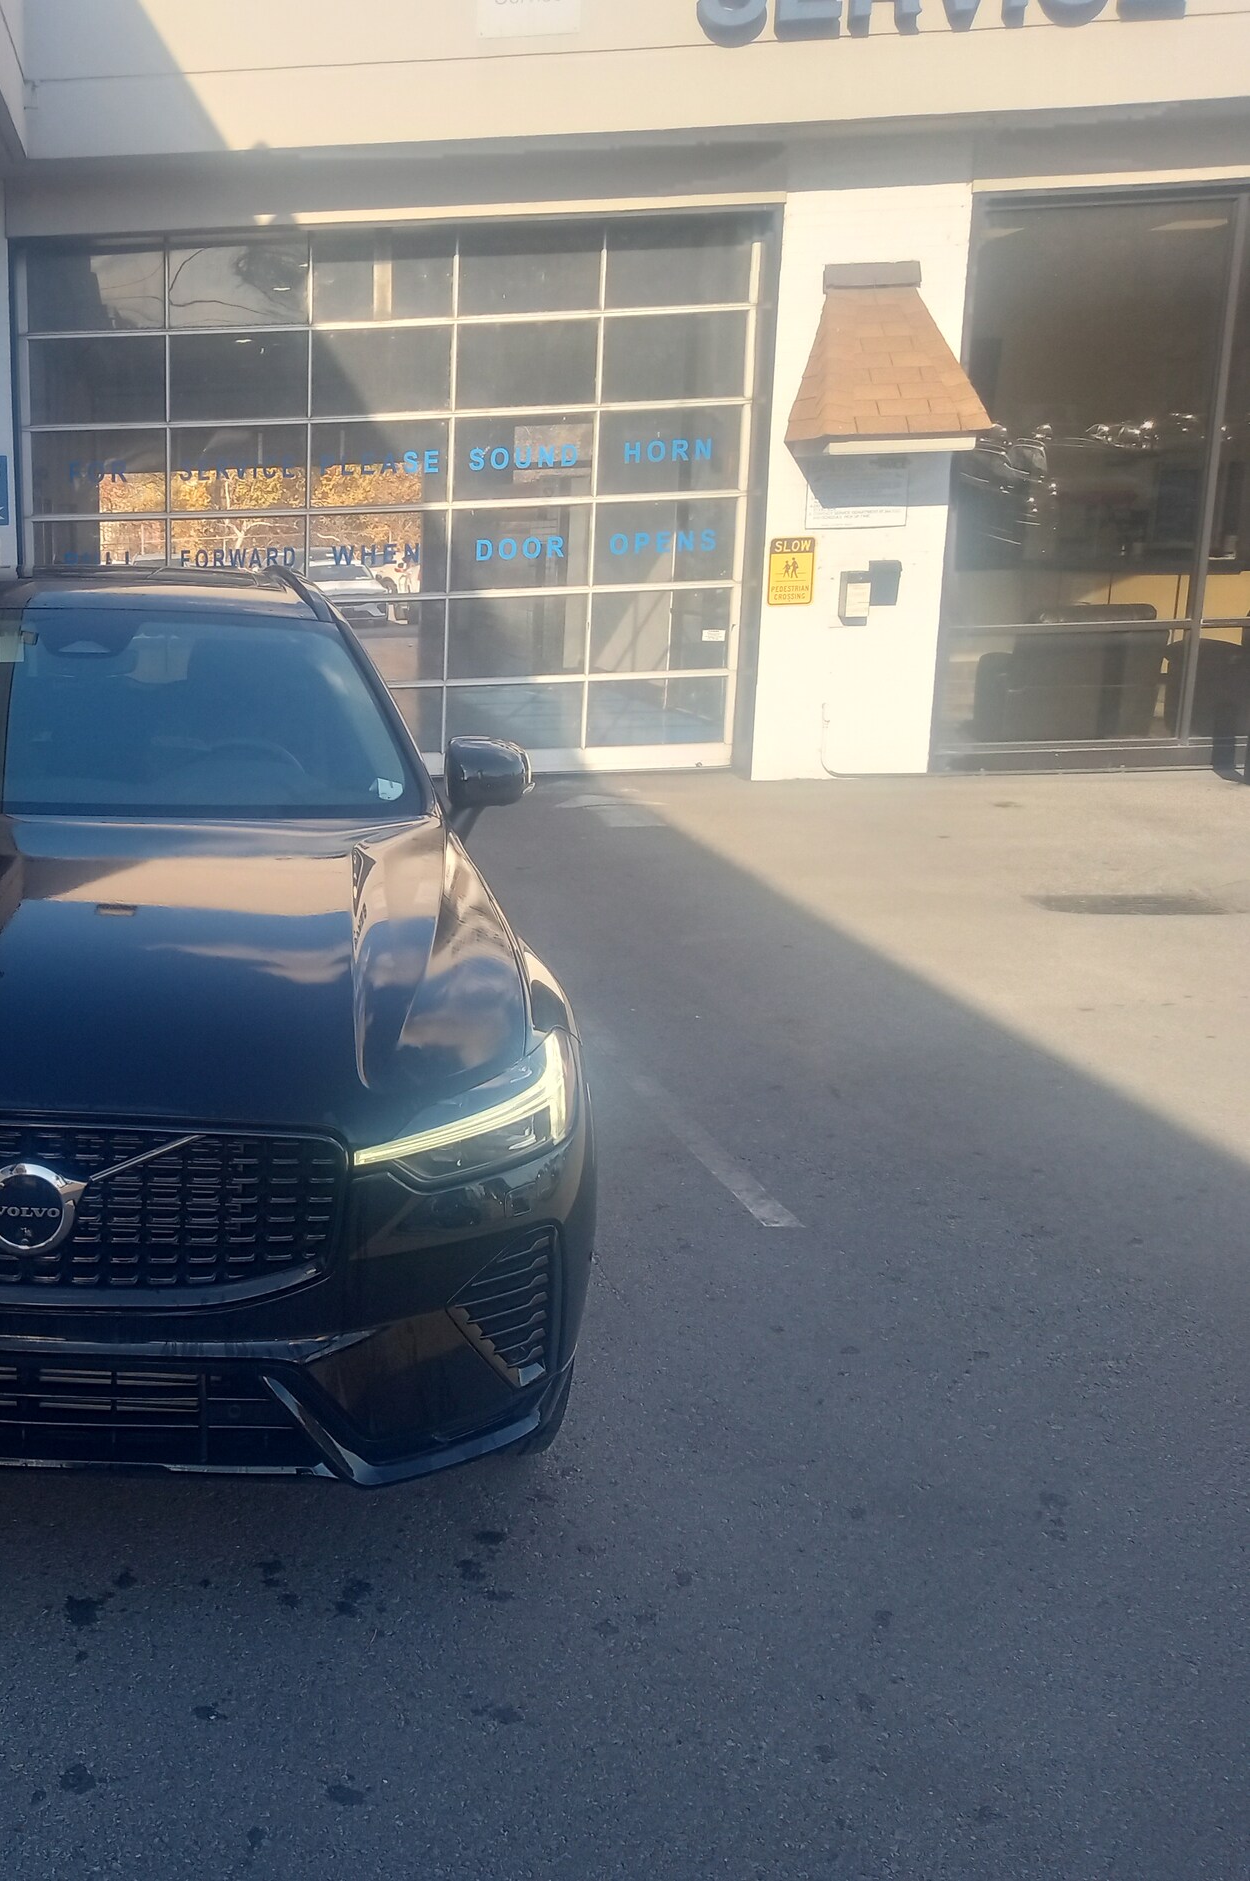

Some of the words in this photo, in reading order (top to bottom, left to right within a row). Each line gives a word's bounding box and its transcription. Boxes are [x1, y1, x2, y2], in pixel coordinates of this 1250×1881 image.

[69, 459, 128, 483] FOR
[320, 449, 440, 477] PLEASE
[468, 444, 578, 471] SOUND
[623, 438, 713, 464] HORN
[180, 545, 297, 569] FORWARD
[332, 542, 420, 567] WHEN
[475, 536, 565, 562] DOOR
[609, 528, 717, 556] OPENS
[774, 540, 812, 553] SLOW
[770, 585, 810, 593] PEDESTRIAN
[773, 593, 806, 601] CROSSING
